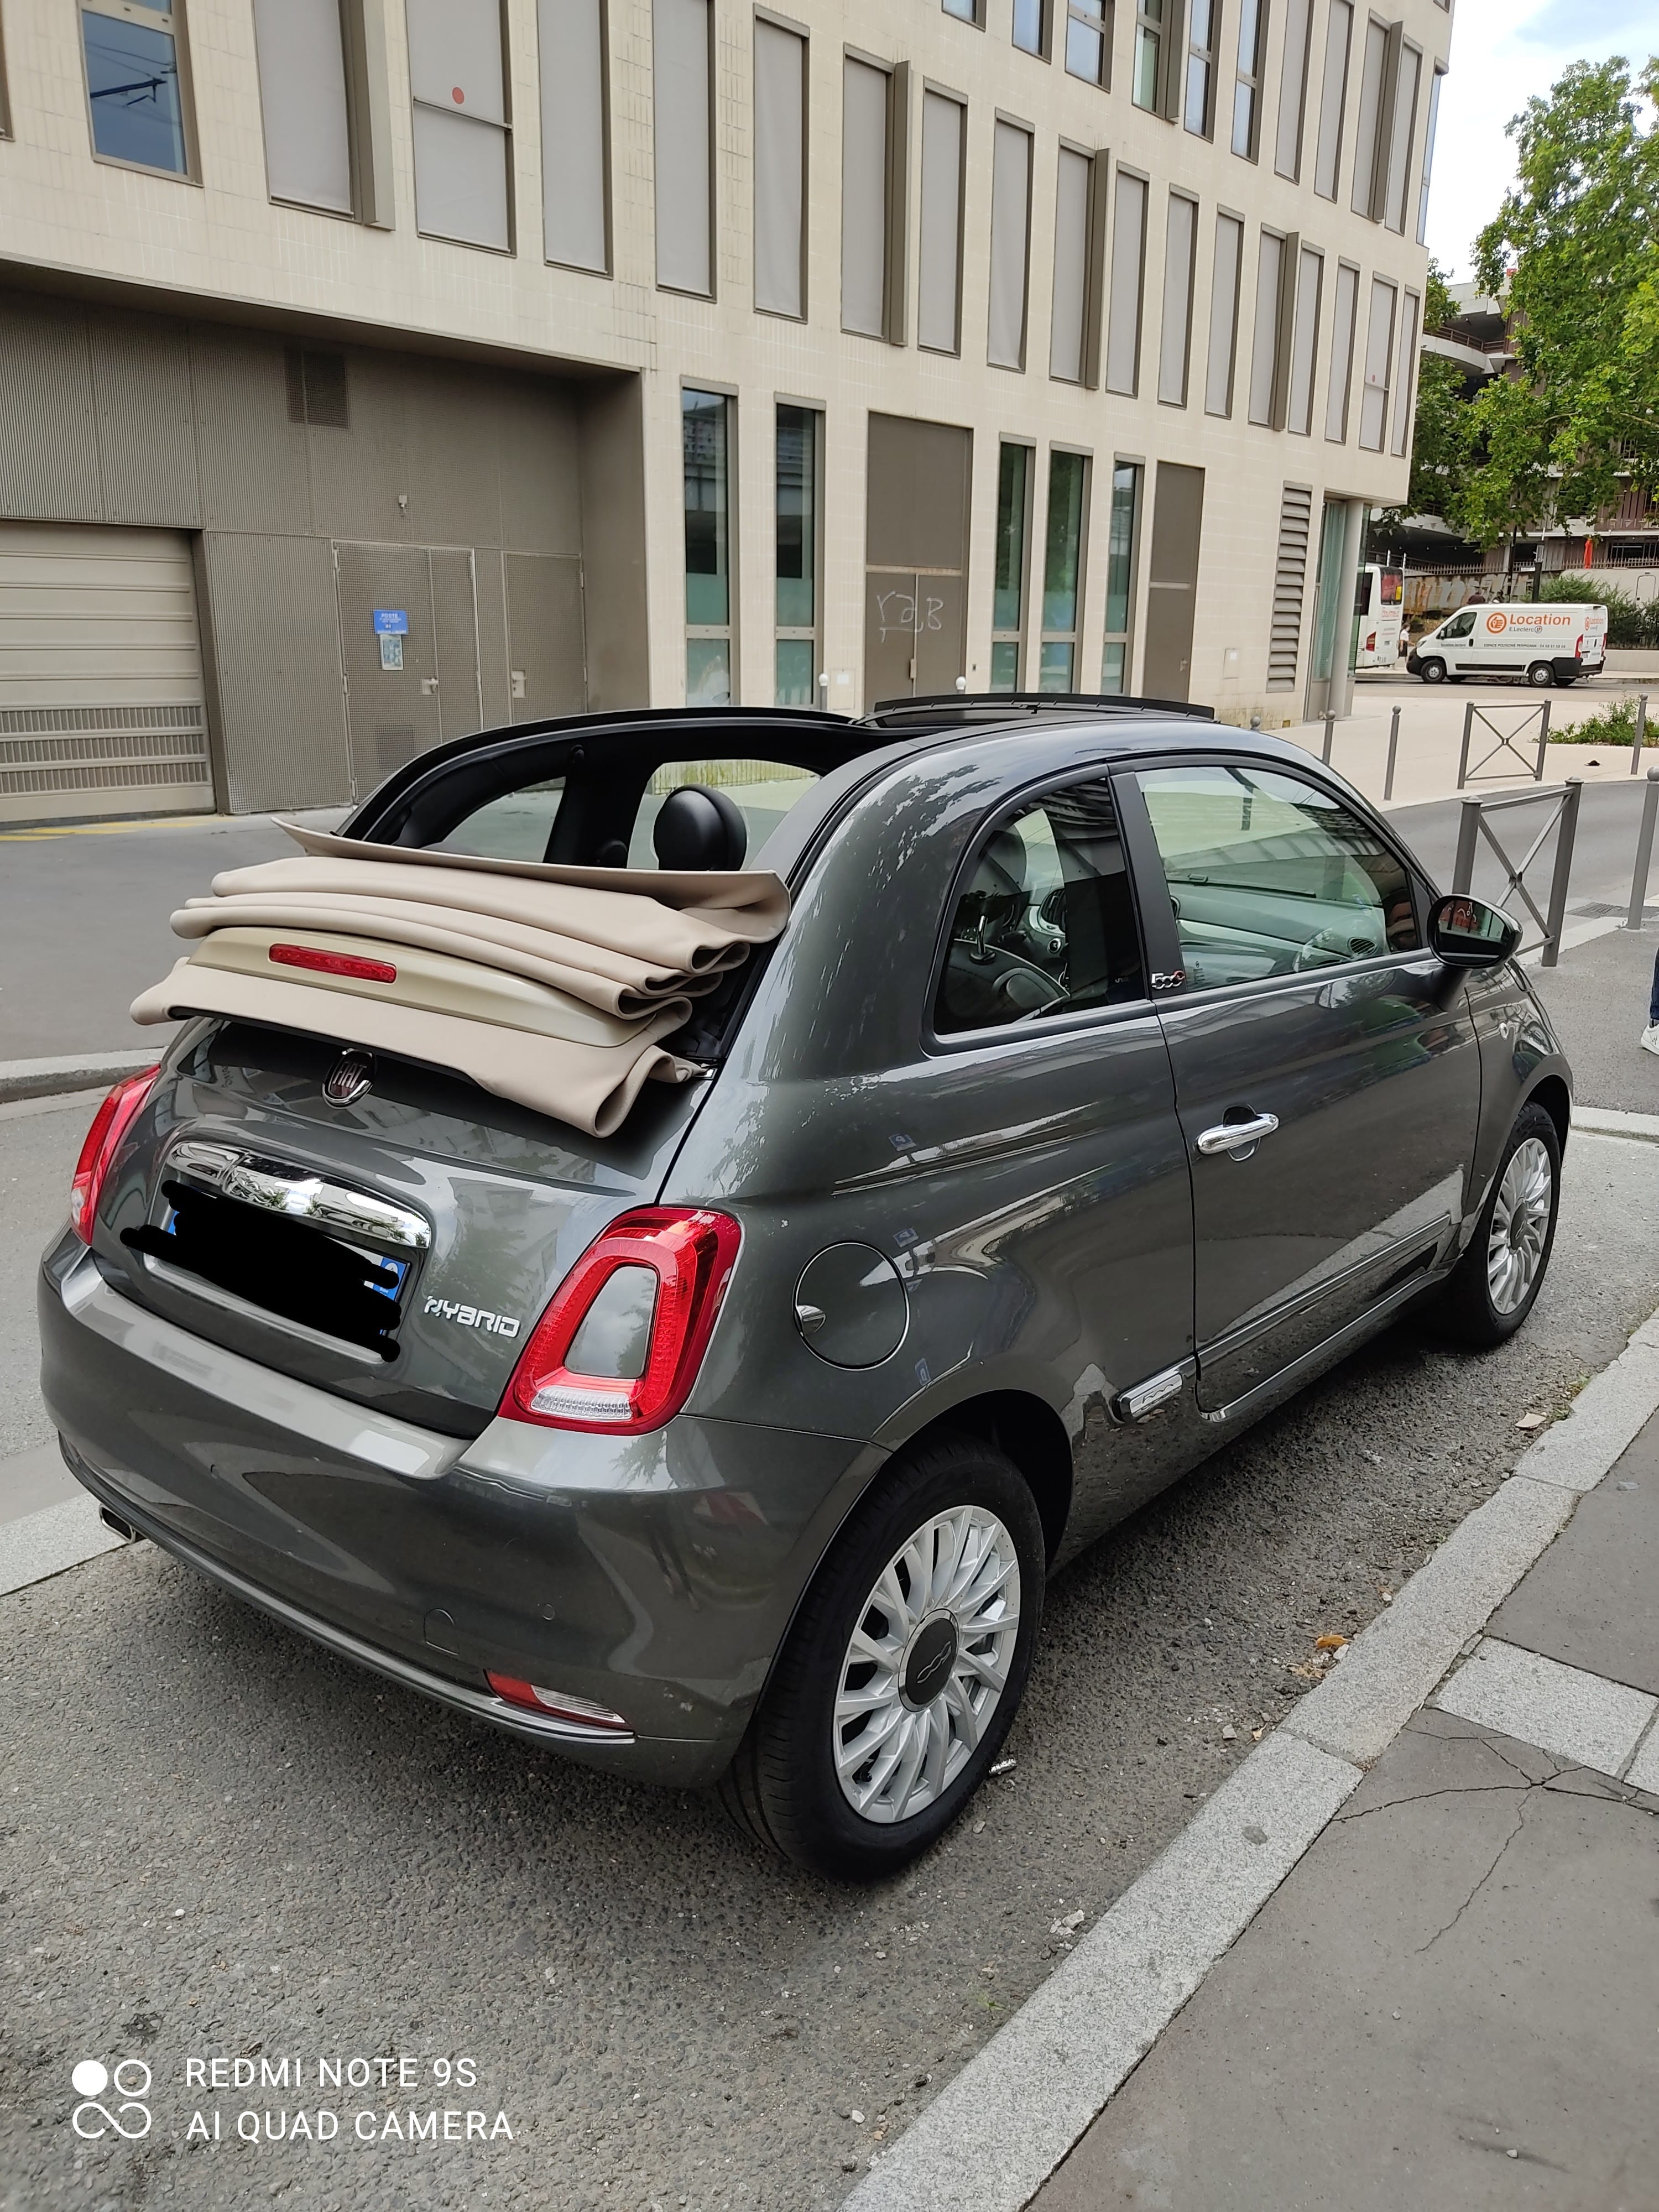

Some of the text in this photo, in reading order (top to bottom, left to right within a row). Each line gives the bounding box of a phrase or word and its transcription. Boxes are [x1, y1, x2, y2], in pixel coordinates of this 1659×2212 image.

[1510, 613, 1571, 625] Location
[332, 1061, 367, 1089] FIAT
[424, 1295, 521, 1338] HYBRID
